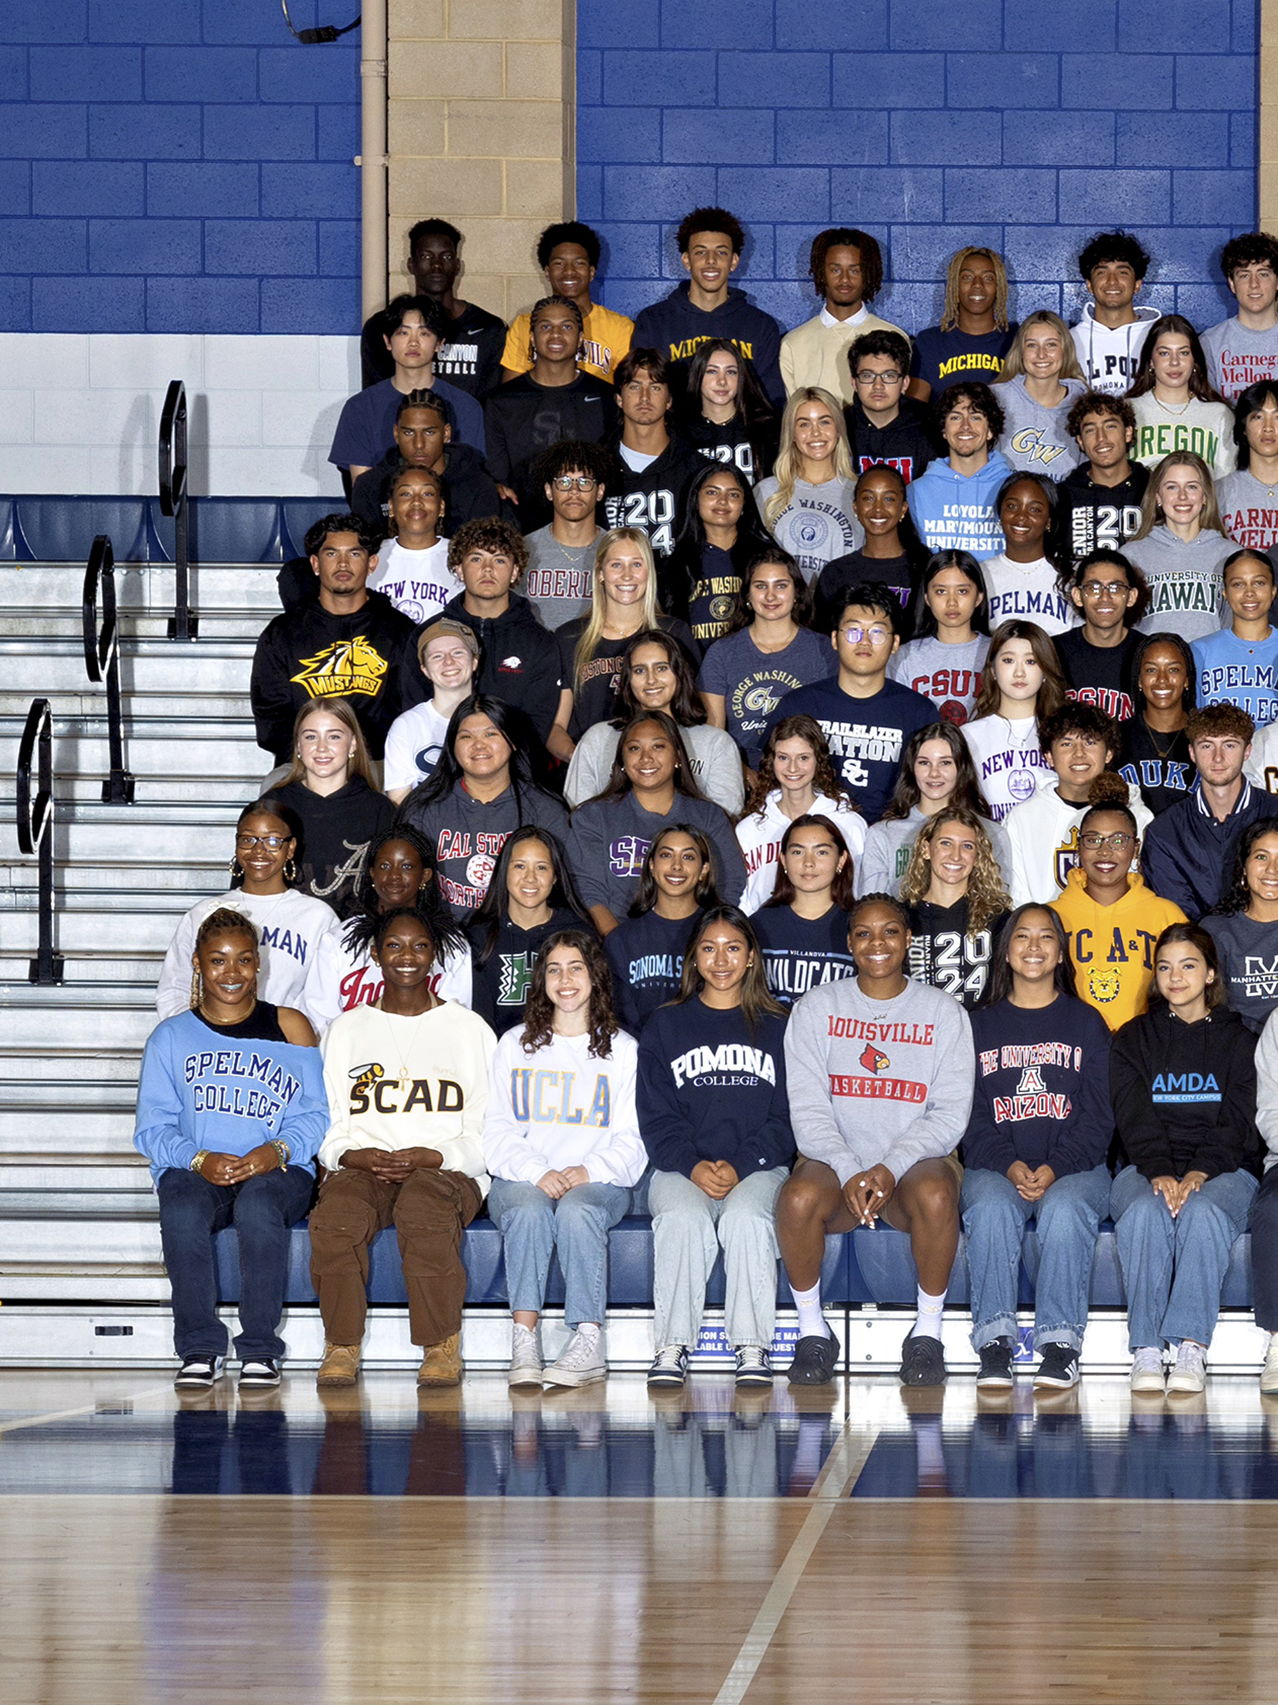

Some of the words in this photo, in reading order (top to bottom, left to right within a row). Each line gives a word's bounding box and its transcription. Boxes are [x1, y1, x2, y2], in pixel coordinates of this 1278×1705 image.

[1010, 426, 1069, 466] GW
[624, 489, 675, 525] 20
[799, 499, 853, 548] WASHINGTON
[1072, 506, 1087, 558] ENIOR
[409, 580, 450, 605] YORK
[1147, 571, 1209, 584] UNIVERSITY
[309, 675, 377, 692] MUSTANGS
[732, 677, 755, 719] GEORGE
[841, 759, 869, 787] SC
[982, 748, 1015, 780] NEW
[437, 828, 472, 863] CAL
[789, 949, 828, 957] VILLANOVA
[934, 928, 992, 967] 20
[628, 954, 674, 984] SONOMA
[935, 963, 989, 1003] 24
[670, 1043, 777, 1090] POMONA
[1001, 1043, 1072, 1069] UNIVERSITY
[185, 1051, 300, 1107] SPELMAN
[693, 1075, 760, 1087] COLLEGE
[1016, 1067, 1046, 1095] A
[1152, 1072, 1220, 1092] AMDA
[193, 1084, 281, 1130] COLLEGE
[349, 1078, 465, 1116] SCAD
[510, 1067, 611, 1129] UCLA
[993, 1093, 1073, 1124] ARIZONA
